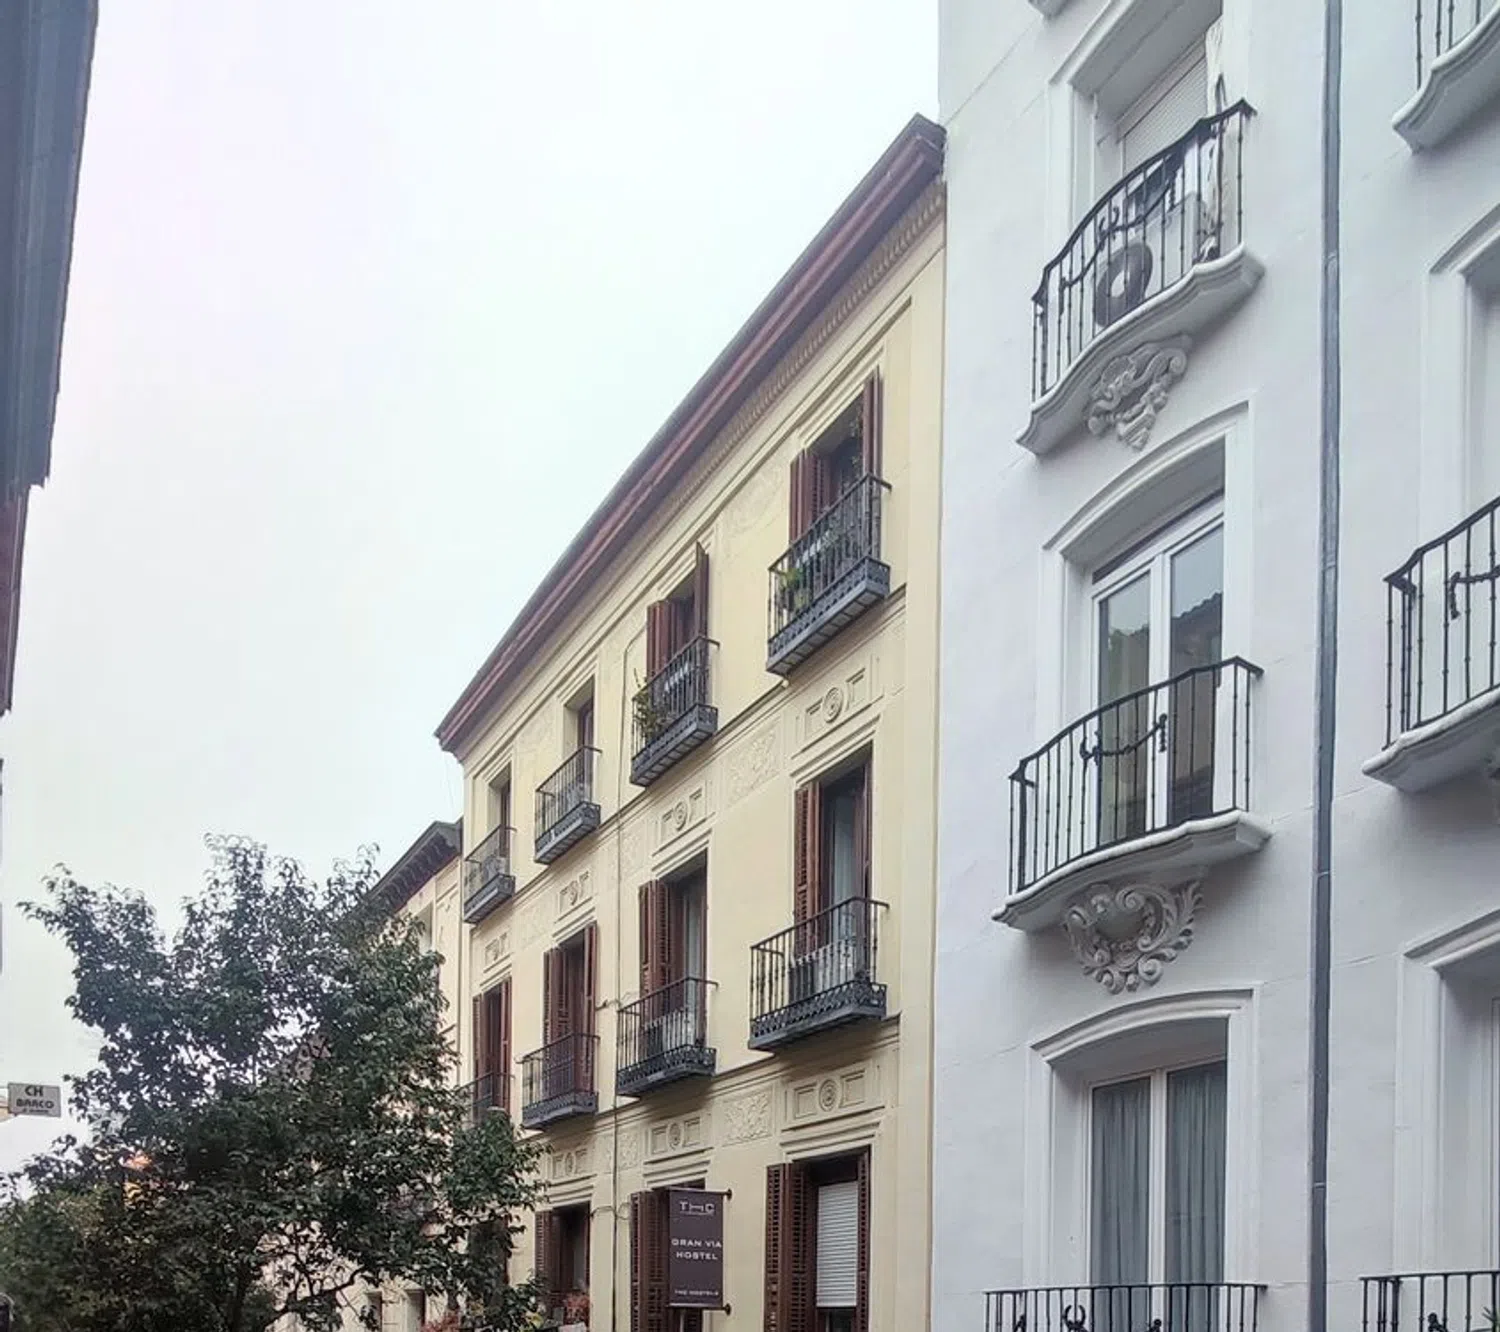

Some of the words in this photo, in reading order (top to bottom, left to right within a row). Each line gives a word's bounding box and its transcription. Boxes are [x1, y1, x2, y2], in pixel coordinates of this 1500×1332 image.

[25, 1085, 44, 1096] CH
[679, 1201, 715, 1212] THC
[671, 1238, 702, 1247] GRAN
[676, 1251, 718, 1260] HOSTEL
